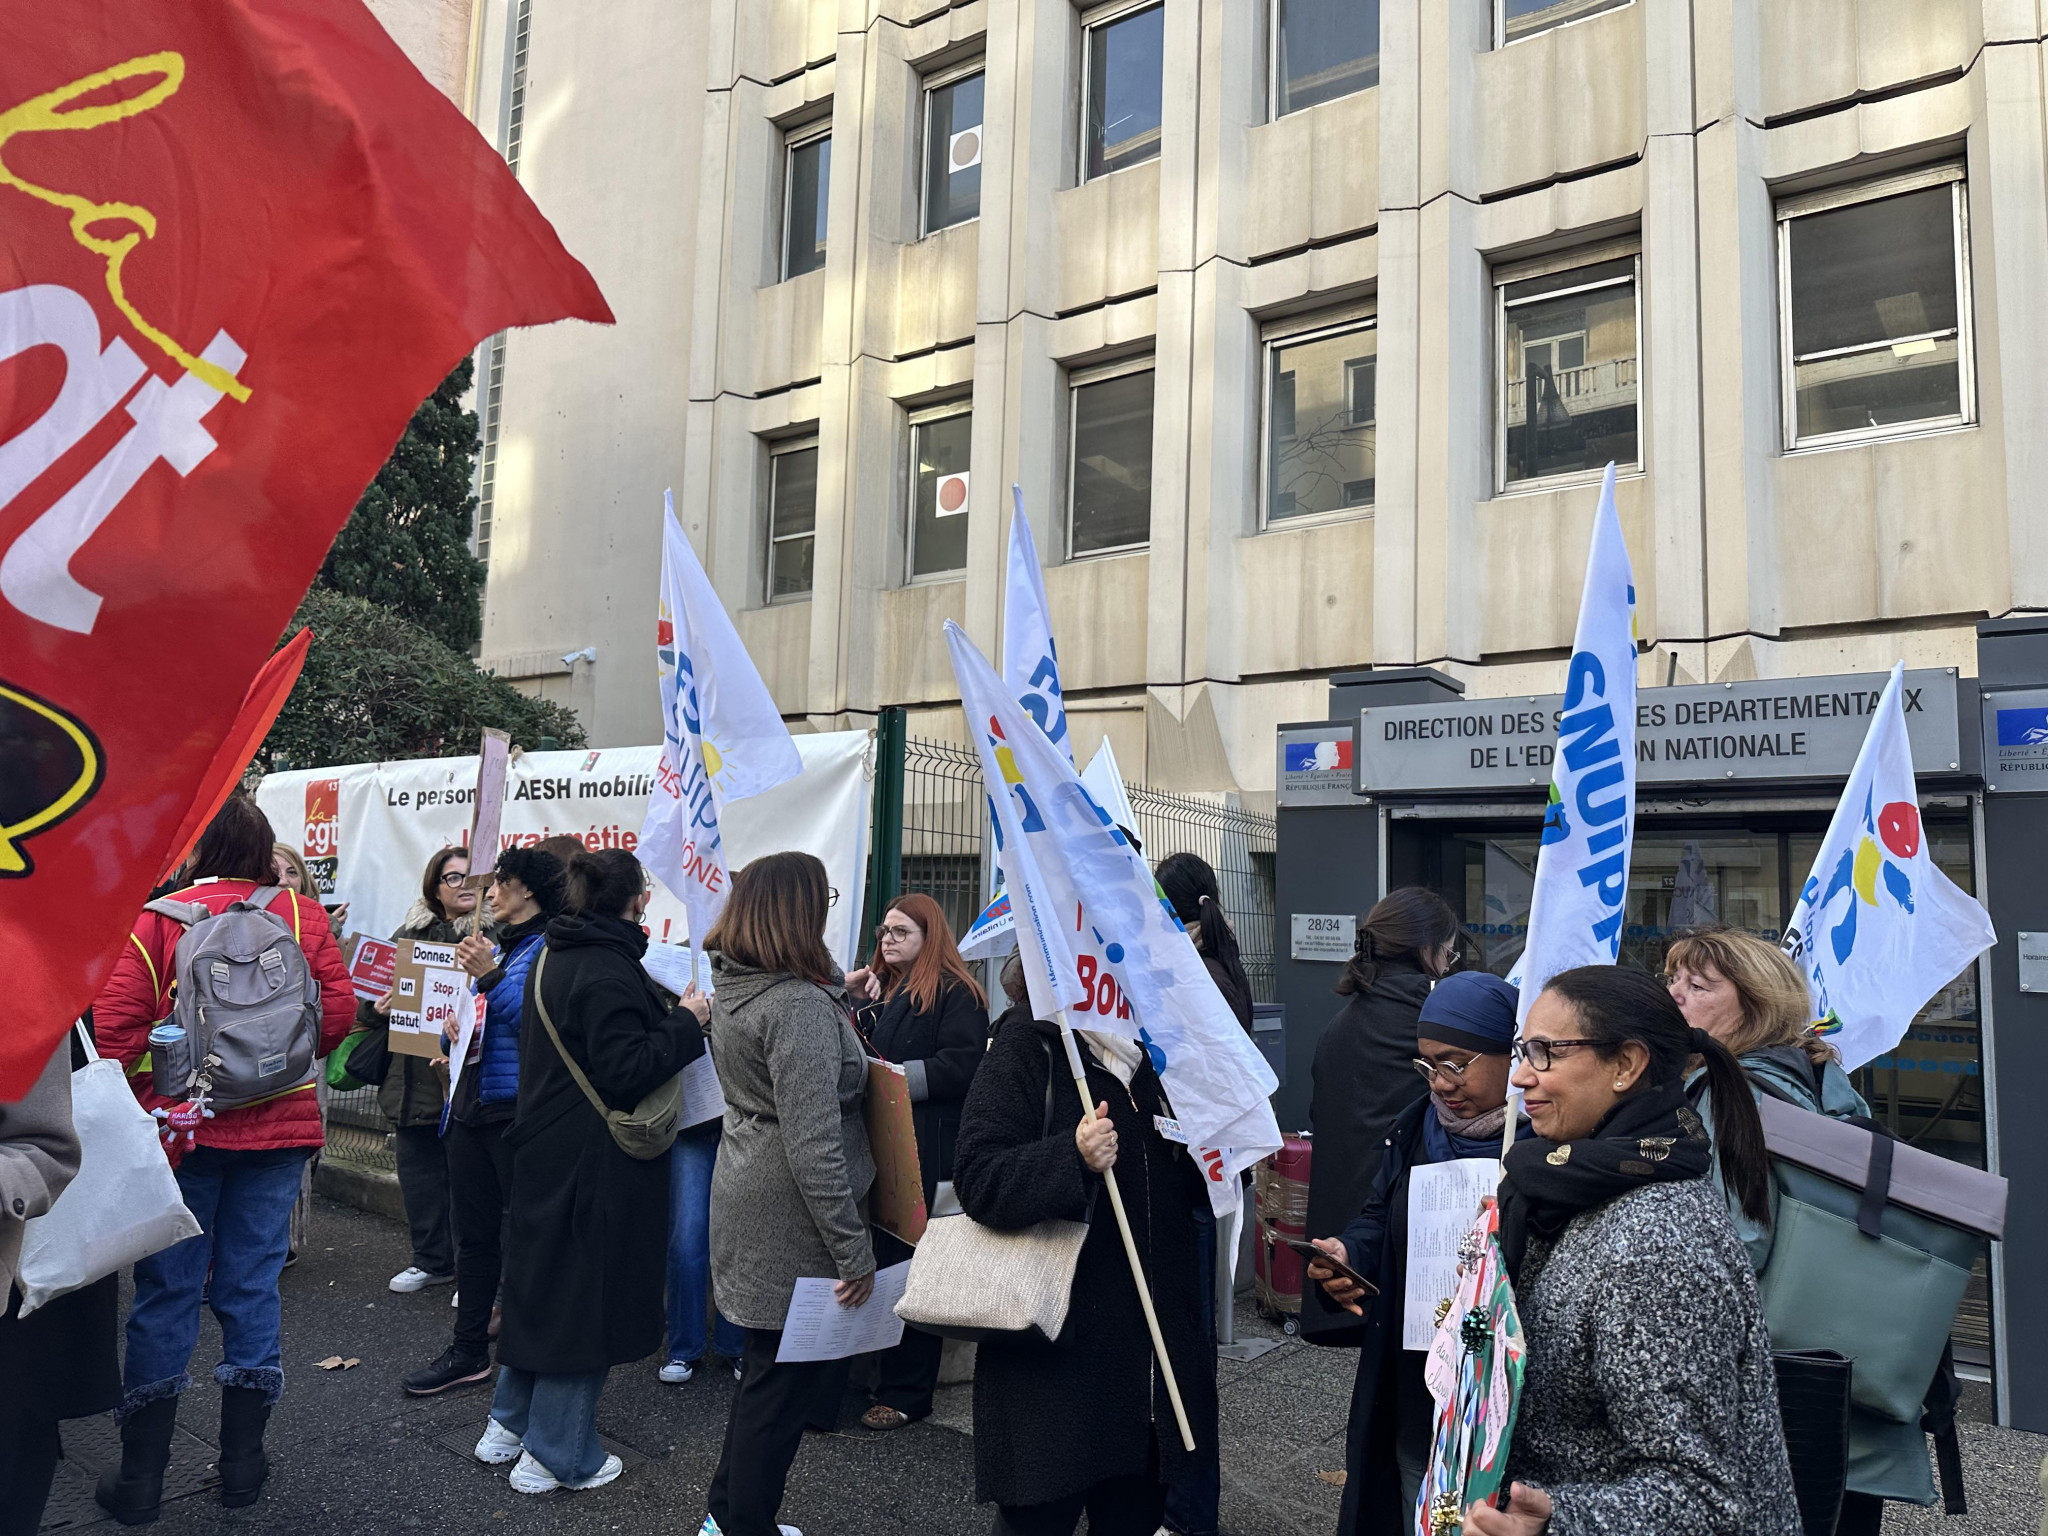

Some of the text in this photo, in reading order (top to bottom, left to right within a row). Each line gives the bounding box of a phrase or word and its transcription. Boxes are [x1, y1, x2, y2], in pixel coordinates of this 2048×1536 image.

[1384, 715, 1493, 741] DIRECTION
[1501, 711, 1545, 735] DES
[1675, 688, 1923, 725] DEPARTEMENTAX
[1470, 748, 1499, 768] DE
[1665, 732, 1807, 761] NATIONALE
[1999, 749, 2029, 757] Liberté
[328, 782, 337, 791] 13
[388, 787, 410, 806] Le
[514, 778, 571, 800] AESH
[305, 815, 339, 854] cgt
[1308, 918, 1340, 931] 28/34
[414, 947, 454, 963] Donnez-
[401, 981, 413, 992] un
[433, 981, 454, 997] Stop
[391, 1013, 419, 1028] statut
